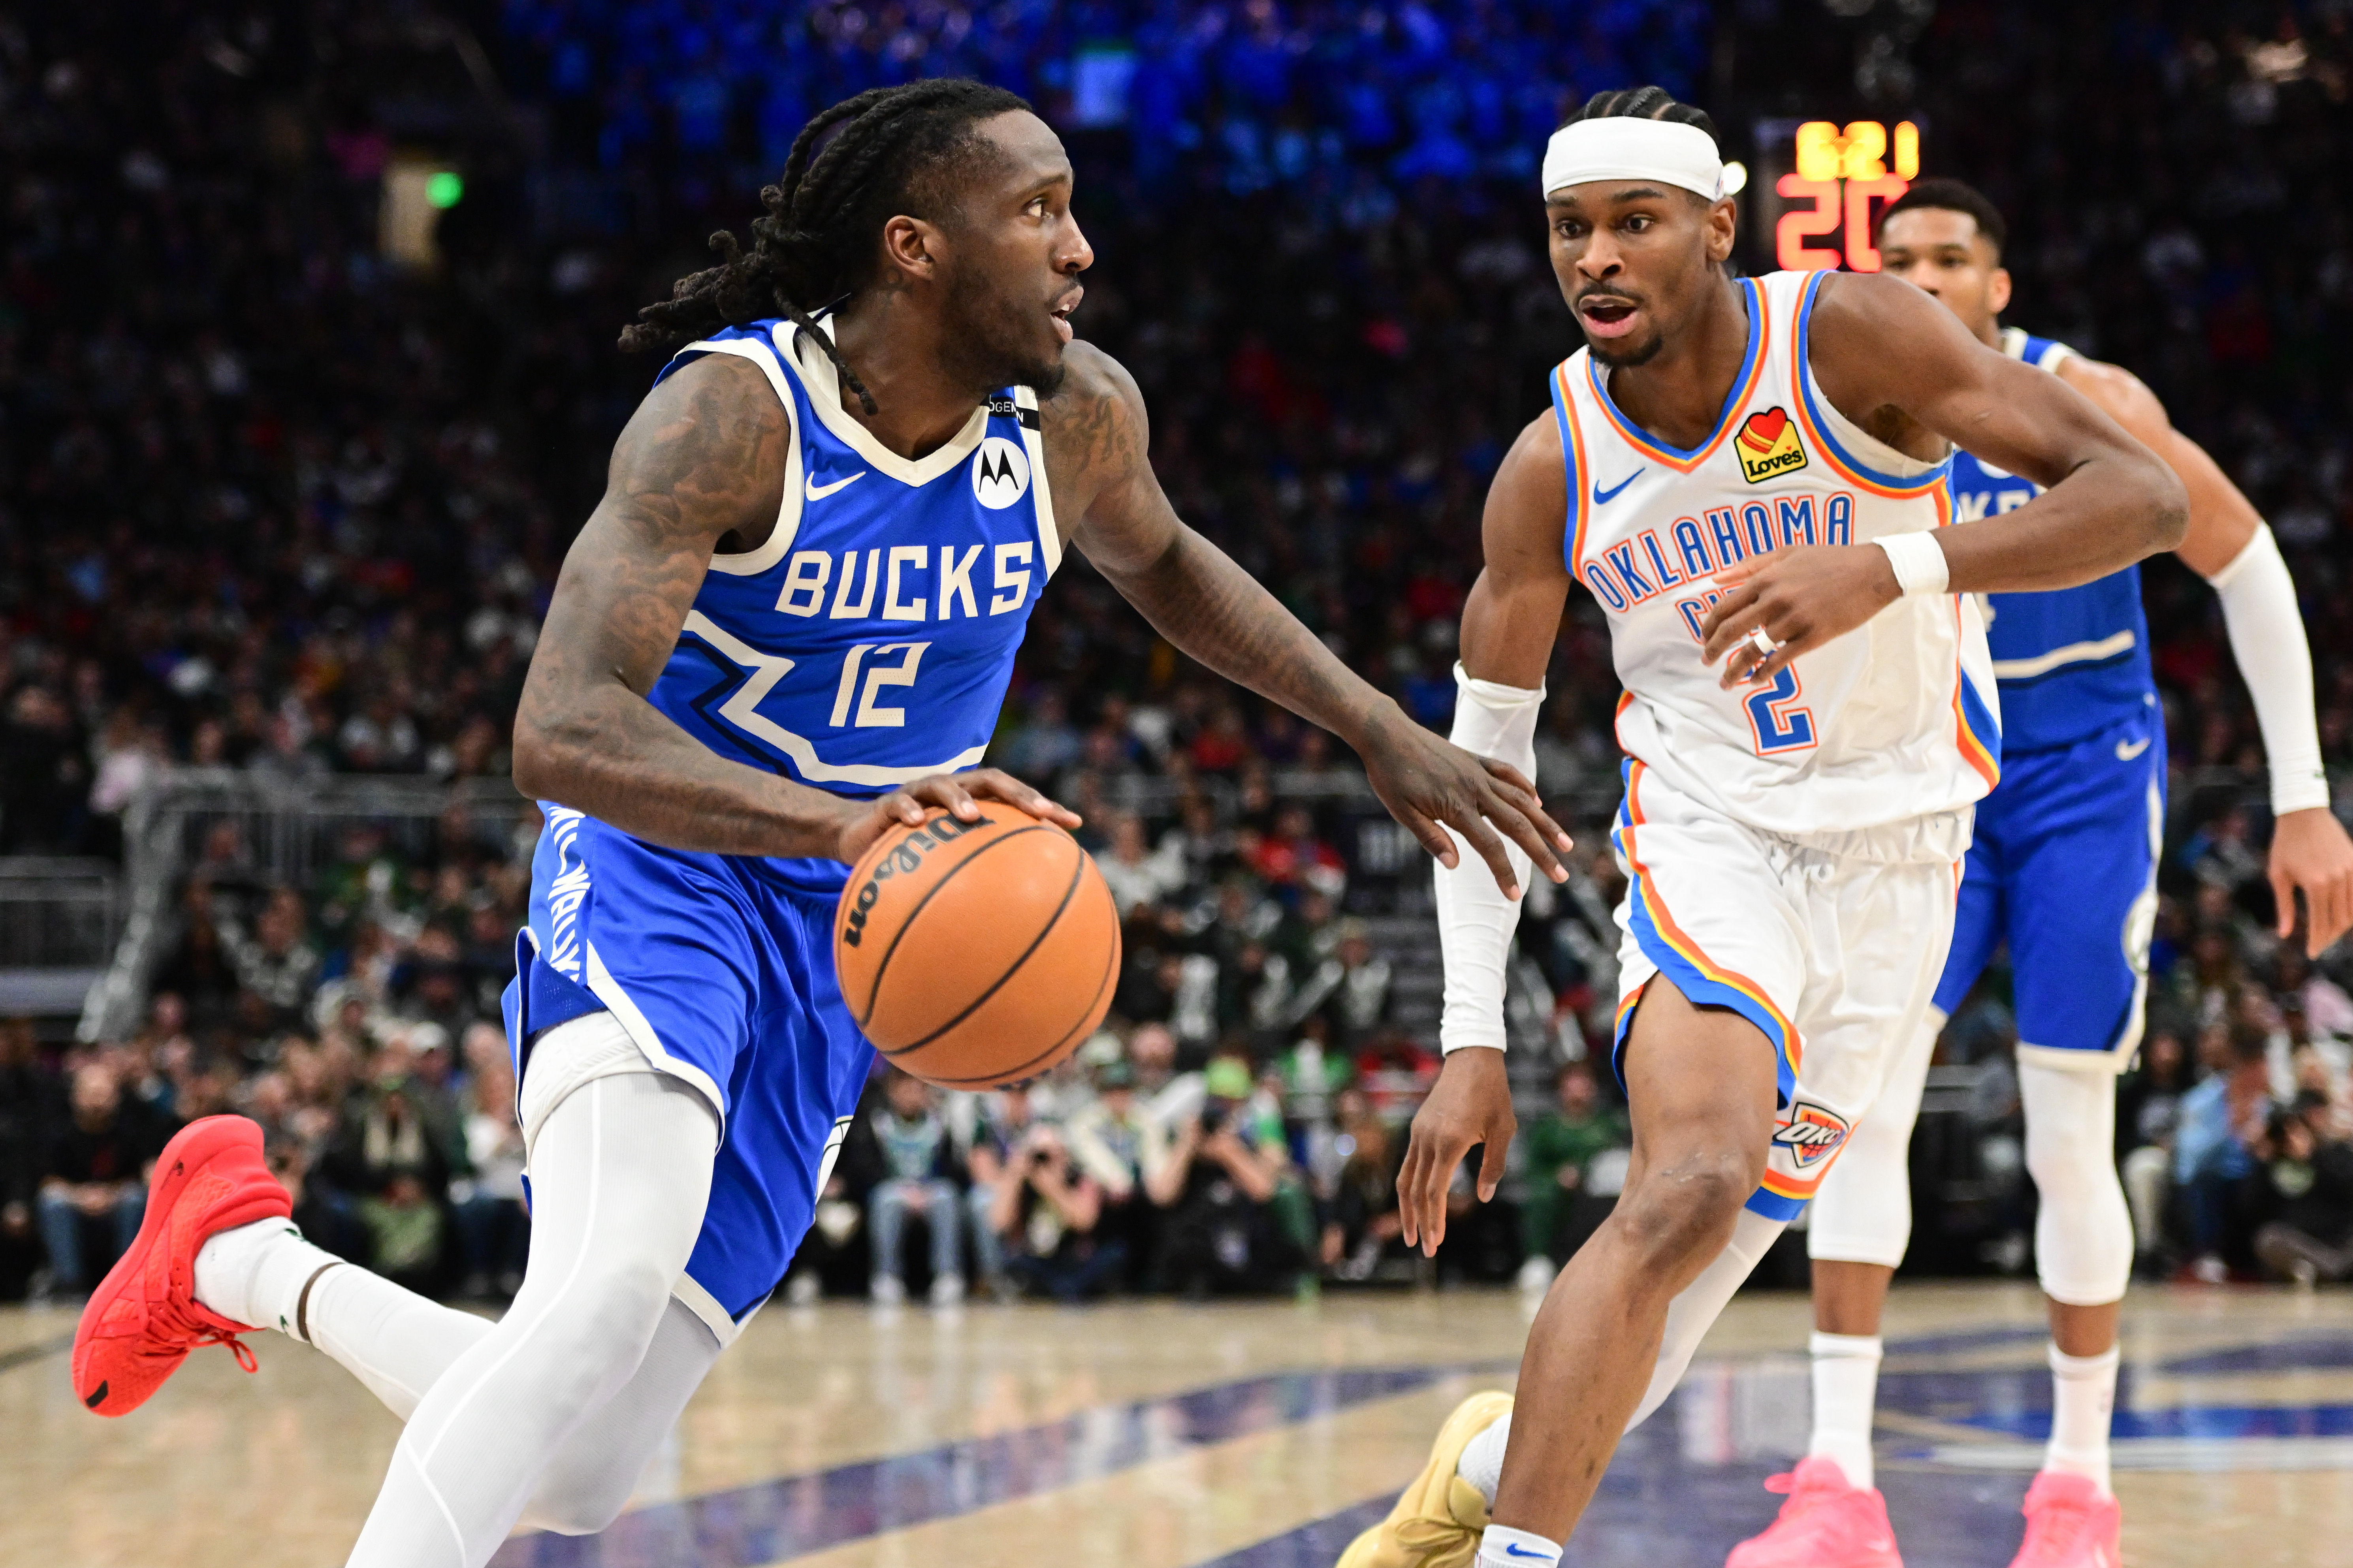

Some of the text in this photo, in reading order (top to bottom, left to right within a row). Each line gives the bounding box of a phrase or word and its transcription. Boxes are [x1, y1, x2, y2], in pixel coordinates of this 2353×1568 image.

[775, 541, 1033, 621] BUCKS
[1583, 491, 1856, 613] OKLAHOMA
[829, 642, 932, 728] 12
[1727, 641, 1818, 756] 2
[844, 813, 997, 948] Wilson
